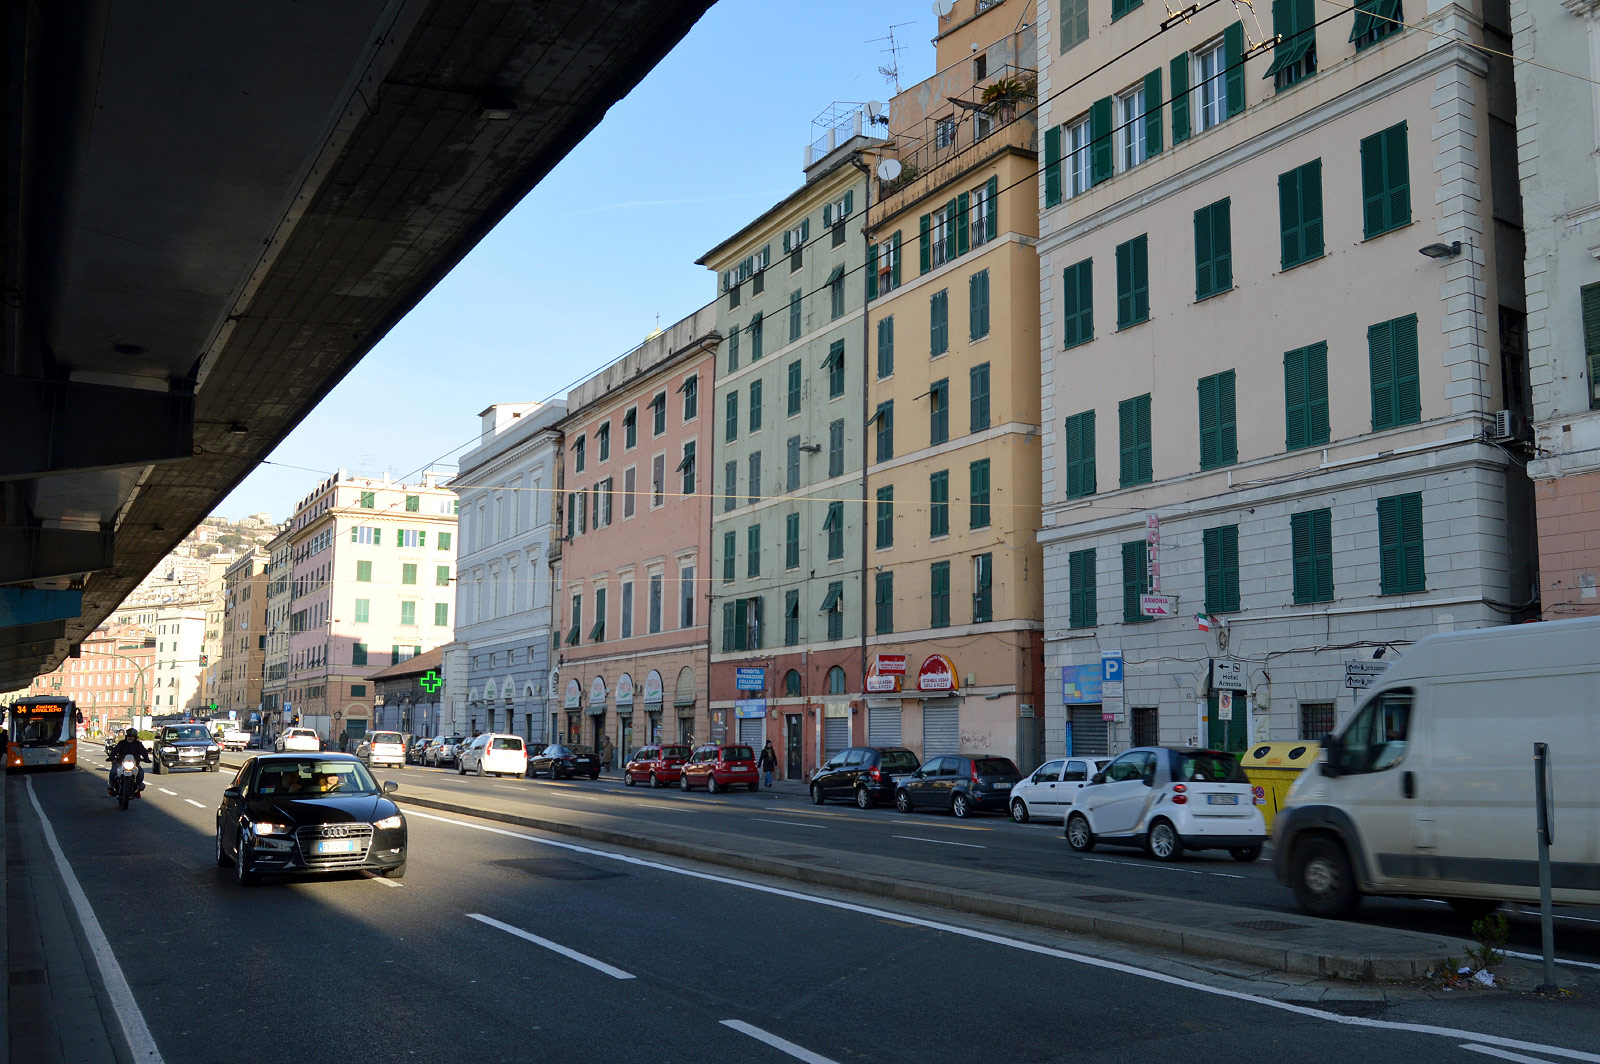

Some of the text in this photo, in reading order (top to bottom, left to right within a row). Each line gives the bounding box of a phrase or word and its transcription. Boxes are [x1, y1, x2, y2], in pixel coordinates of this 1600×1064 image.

[1148, 514, 1160, 592] HOTEL
[1105, 660, 1119, 679] P
[1218, 680, 1242, 688] Armonia
[17, 705, 27, 714] 34
